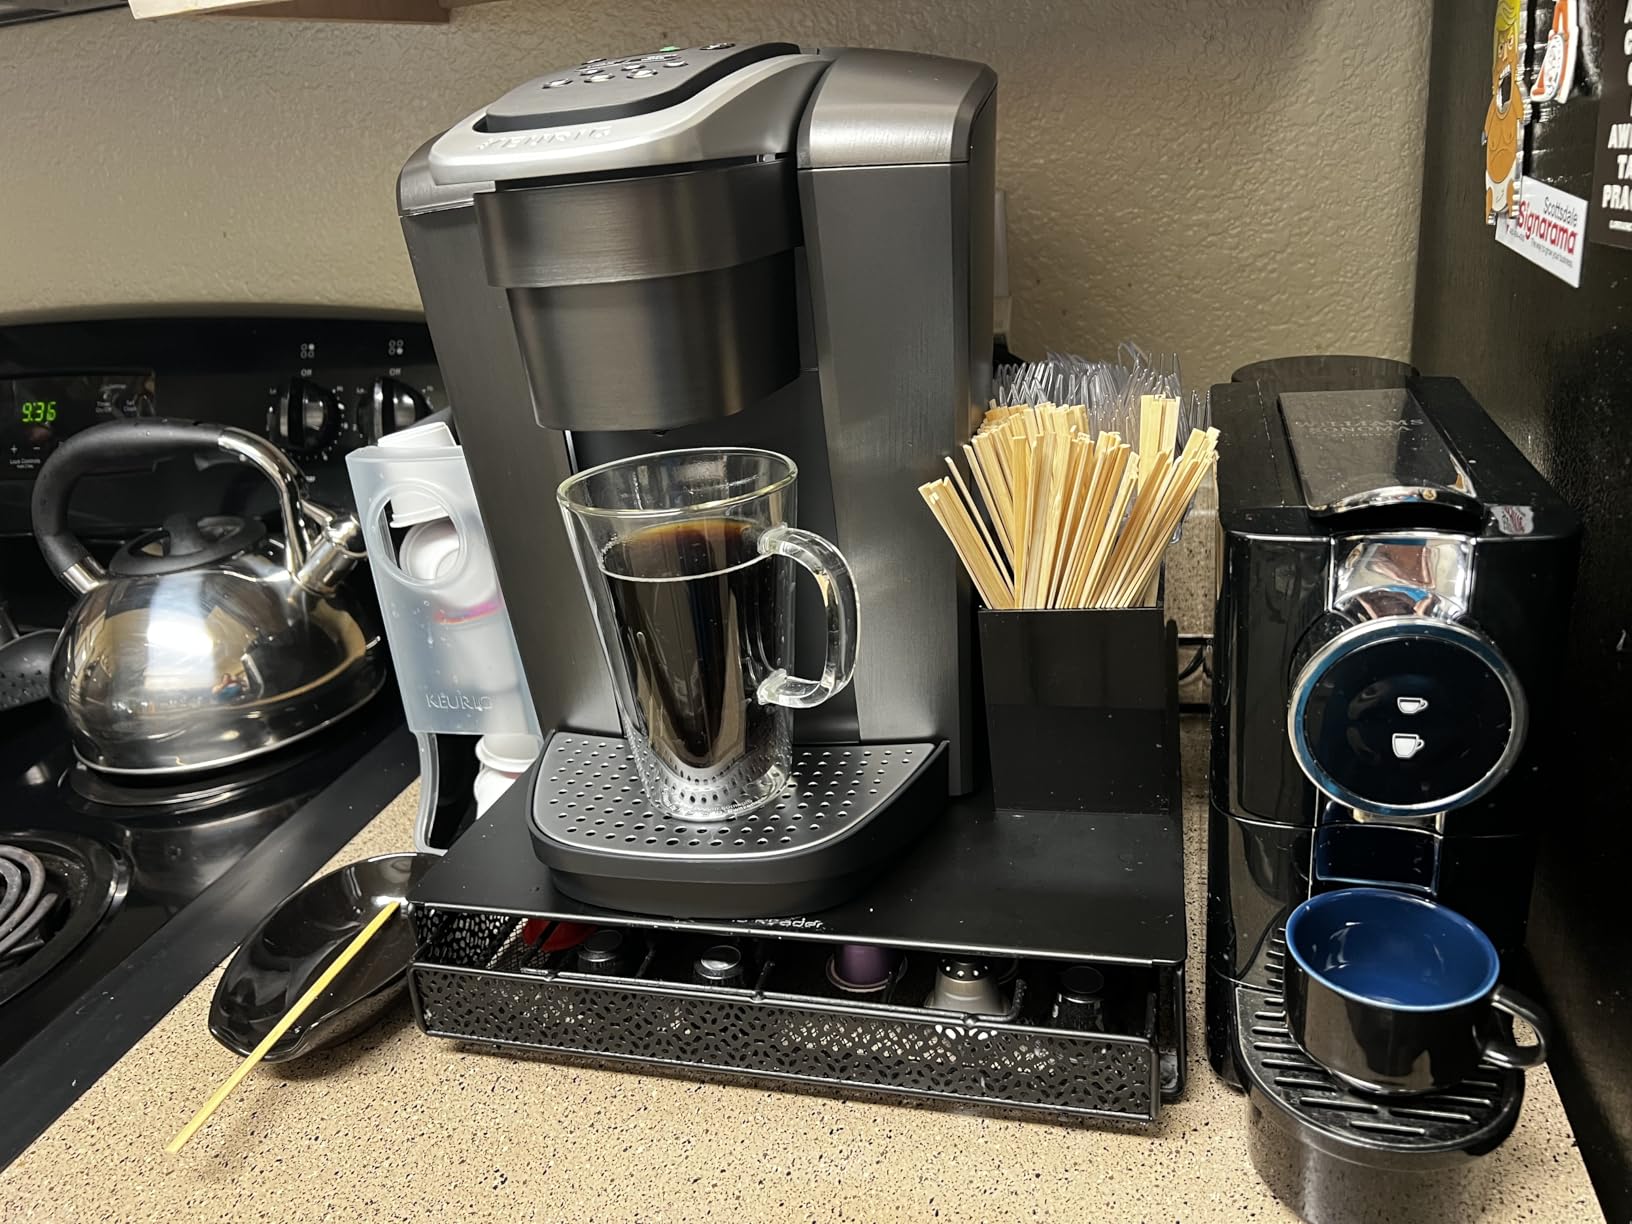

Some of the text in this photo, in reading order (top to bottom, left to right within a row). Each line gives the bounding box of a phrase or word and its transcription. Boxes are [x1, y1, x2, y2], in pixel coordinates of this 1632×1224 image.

[1517, 200, 1579, 255] Signarama
[1543, 196, 1578, 228] Scottsdale
[22, 400, 56, 422] 9:36
